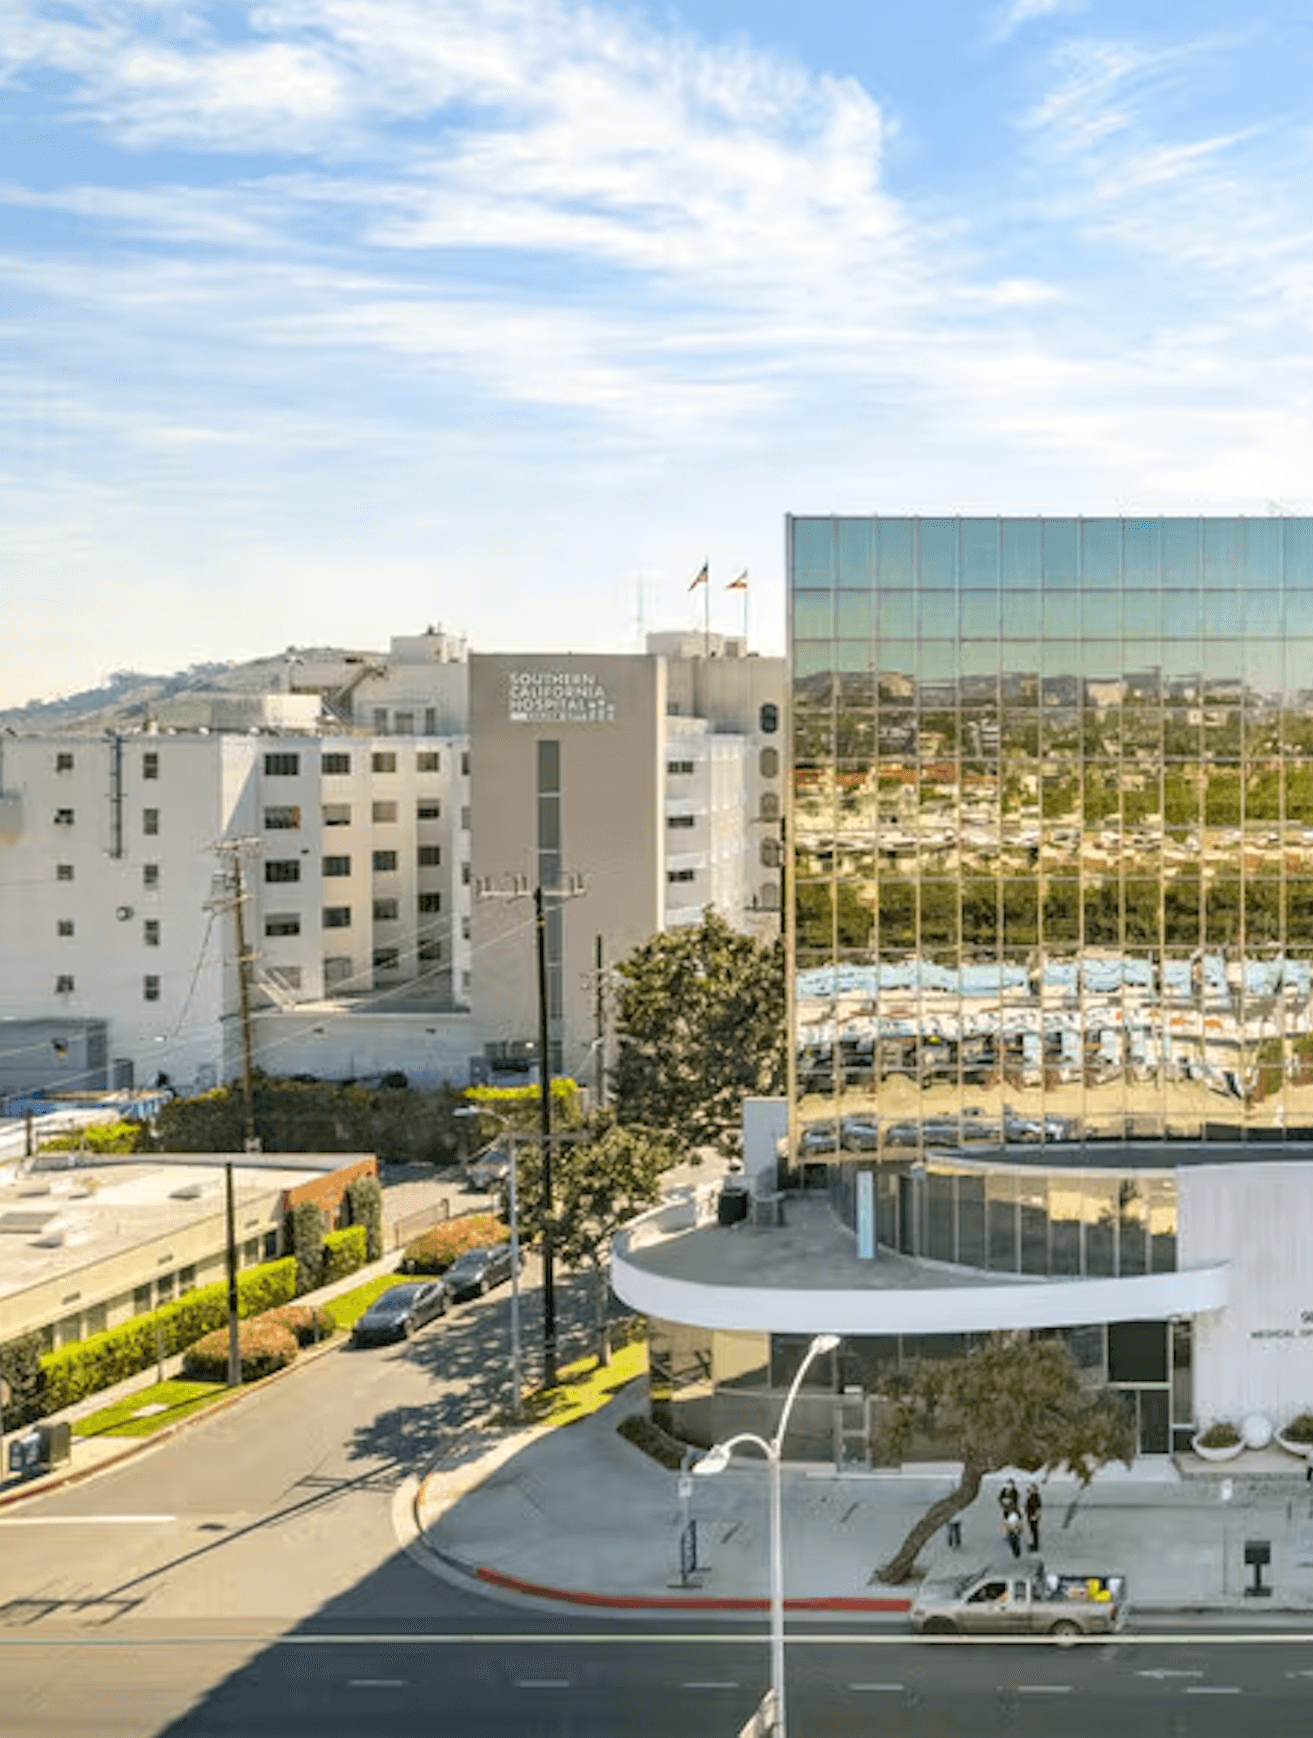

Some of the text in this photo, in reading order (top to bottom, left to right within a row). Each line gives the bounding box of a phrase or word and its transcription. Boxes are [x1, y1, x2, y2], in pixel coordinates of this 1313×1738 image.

[509, 673, 596, 685] SOUTHERN
[509, 685, 605, 698] CALIFORNIA
[509, 698, 587, 711] HOSPITAL
[1250, 1329, 1295, 1339] MEDICAL
